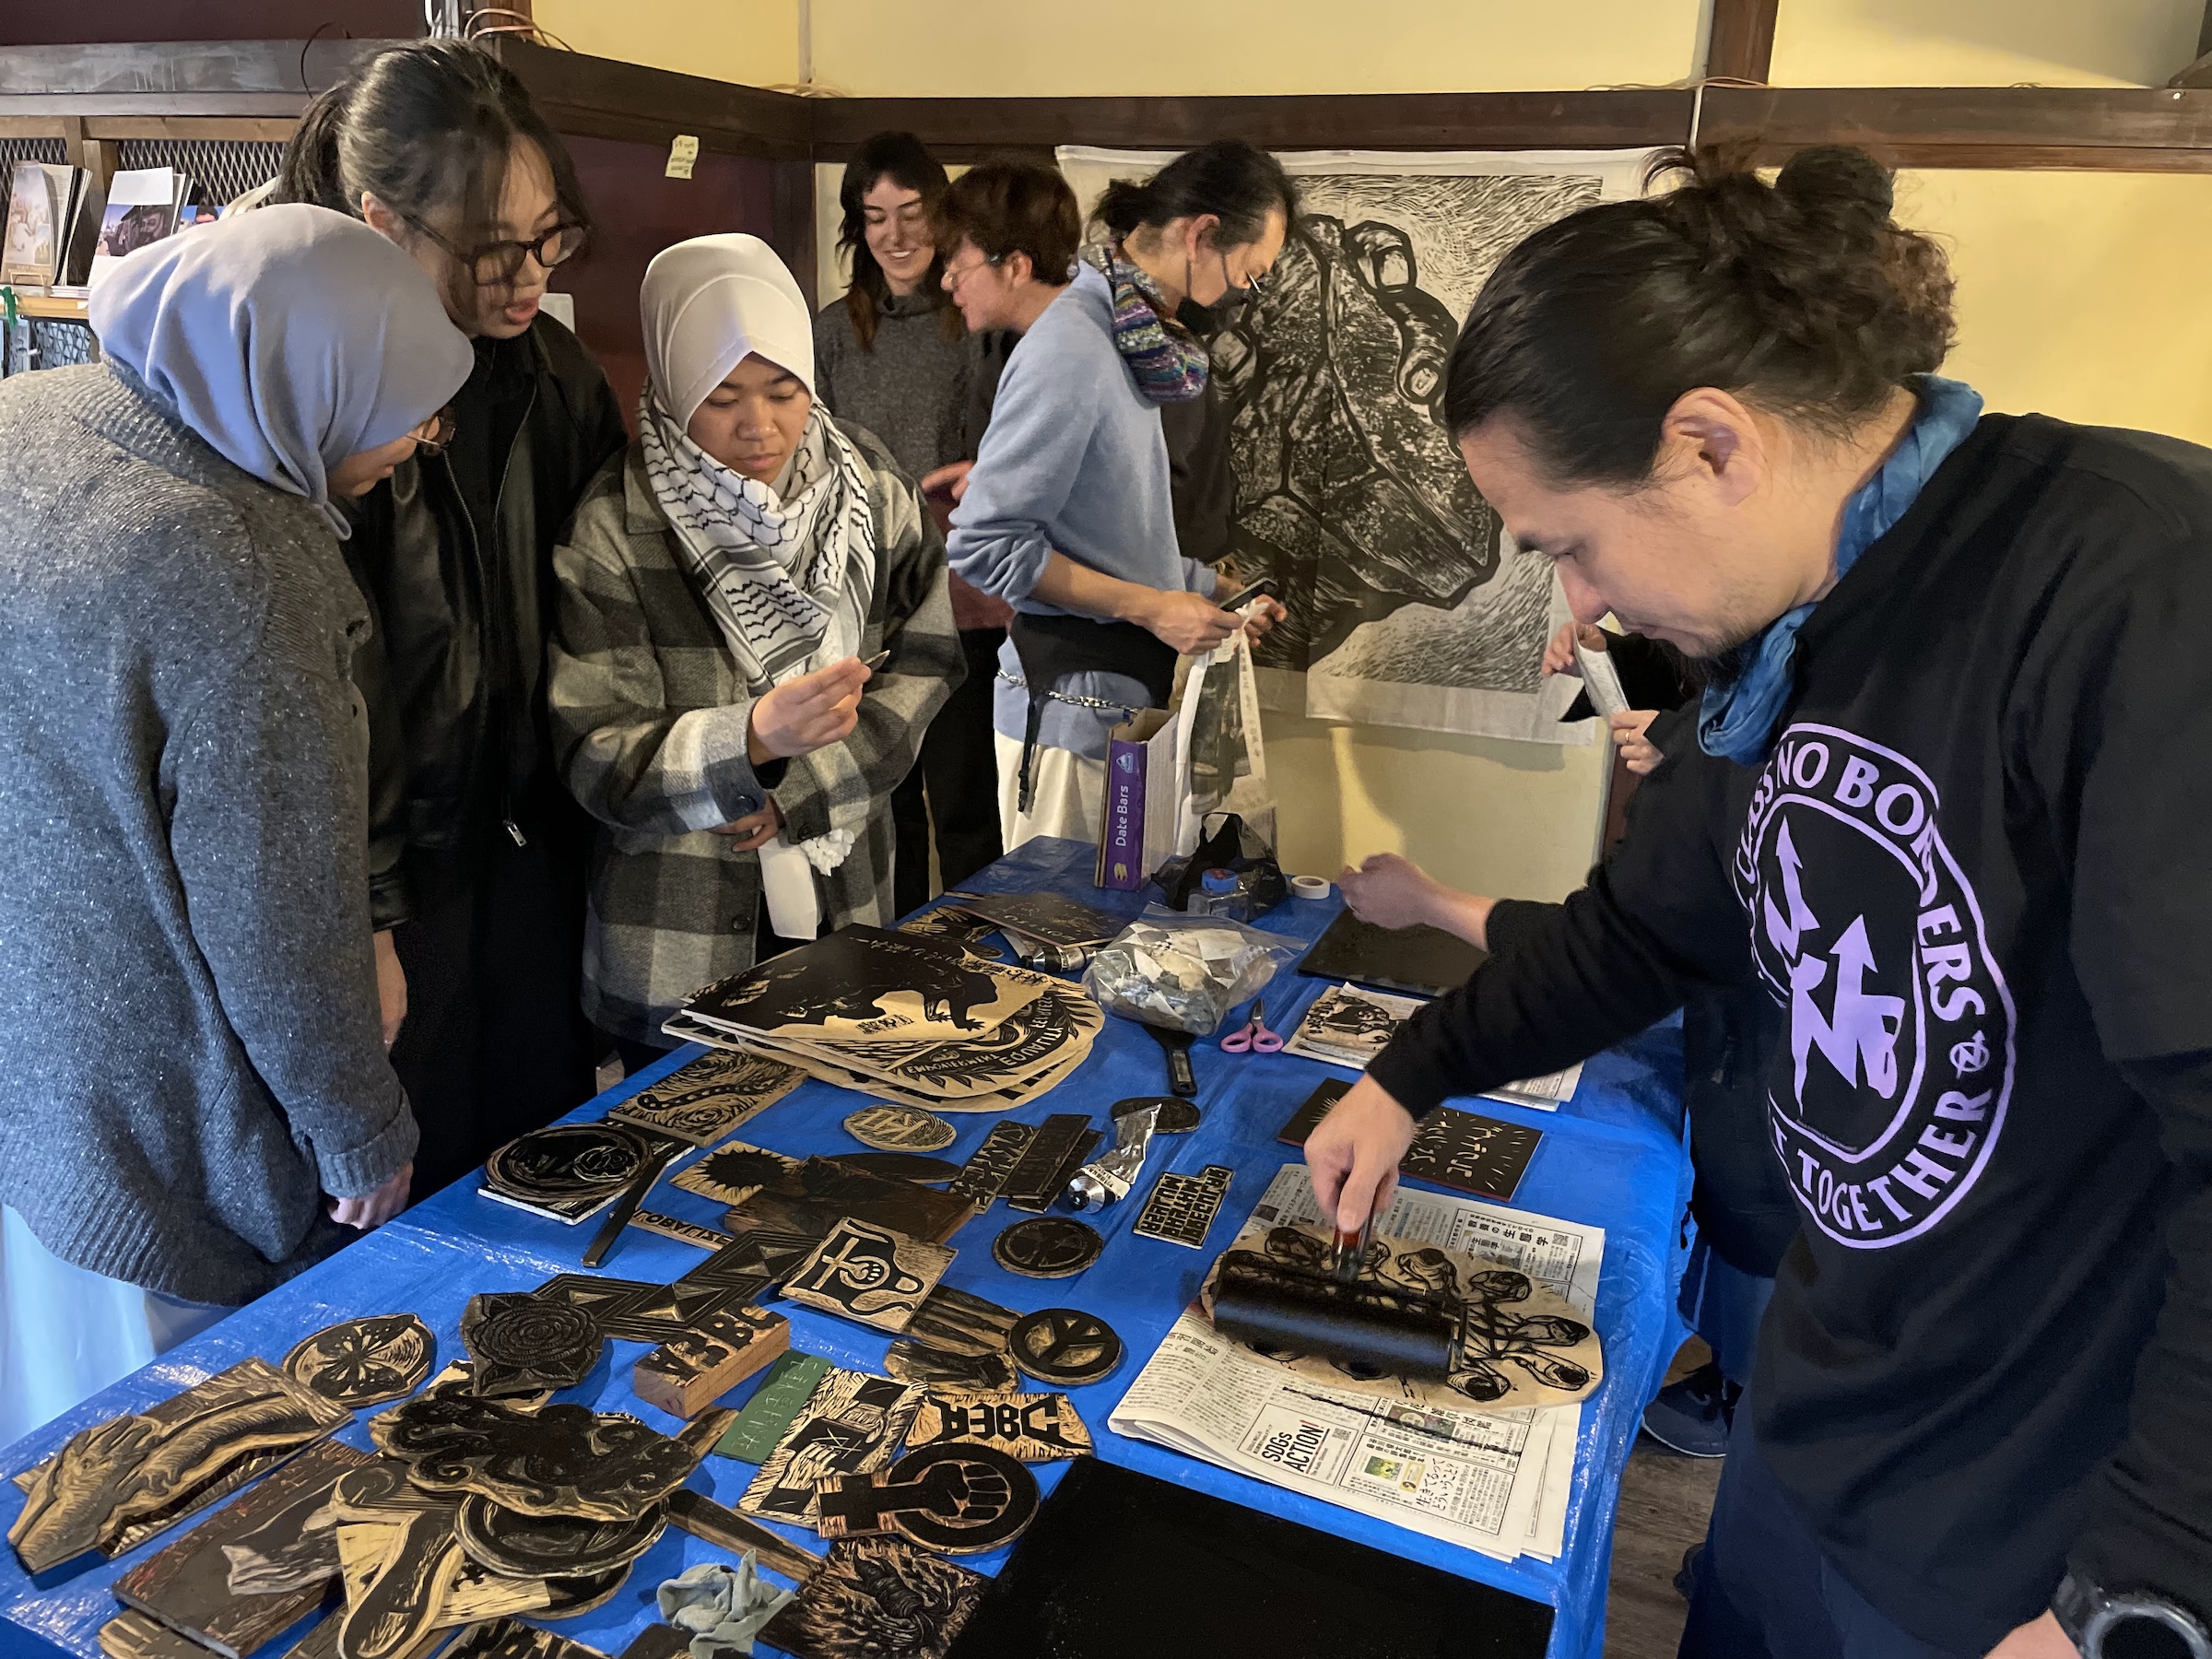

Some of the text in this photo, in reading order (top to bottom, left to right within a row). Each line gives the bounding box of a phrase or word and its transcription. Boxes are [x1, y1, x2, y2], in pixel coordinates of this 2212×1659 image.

[1777, 741, 1830, 789] NO
[1115, 784, 1129, 847] Date Bars
[1796, 1090, 1991, 1231] TOGETHER
[1466, 1218, 1548, 1247] 教養の生態学
[1260, 1430, 1293, 1463] SDGs
[1280, 1418, 1324, 1473] ACTION!
[1414, 1456, 1445, 1508] 生きてるって
